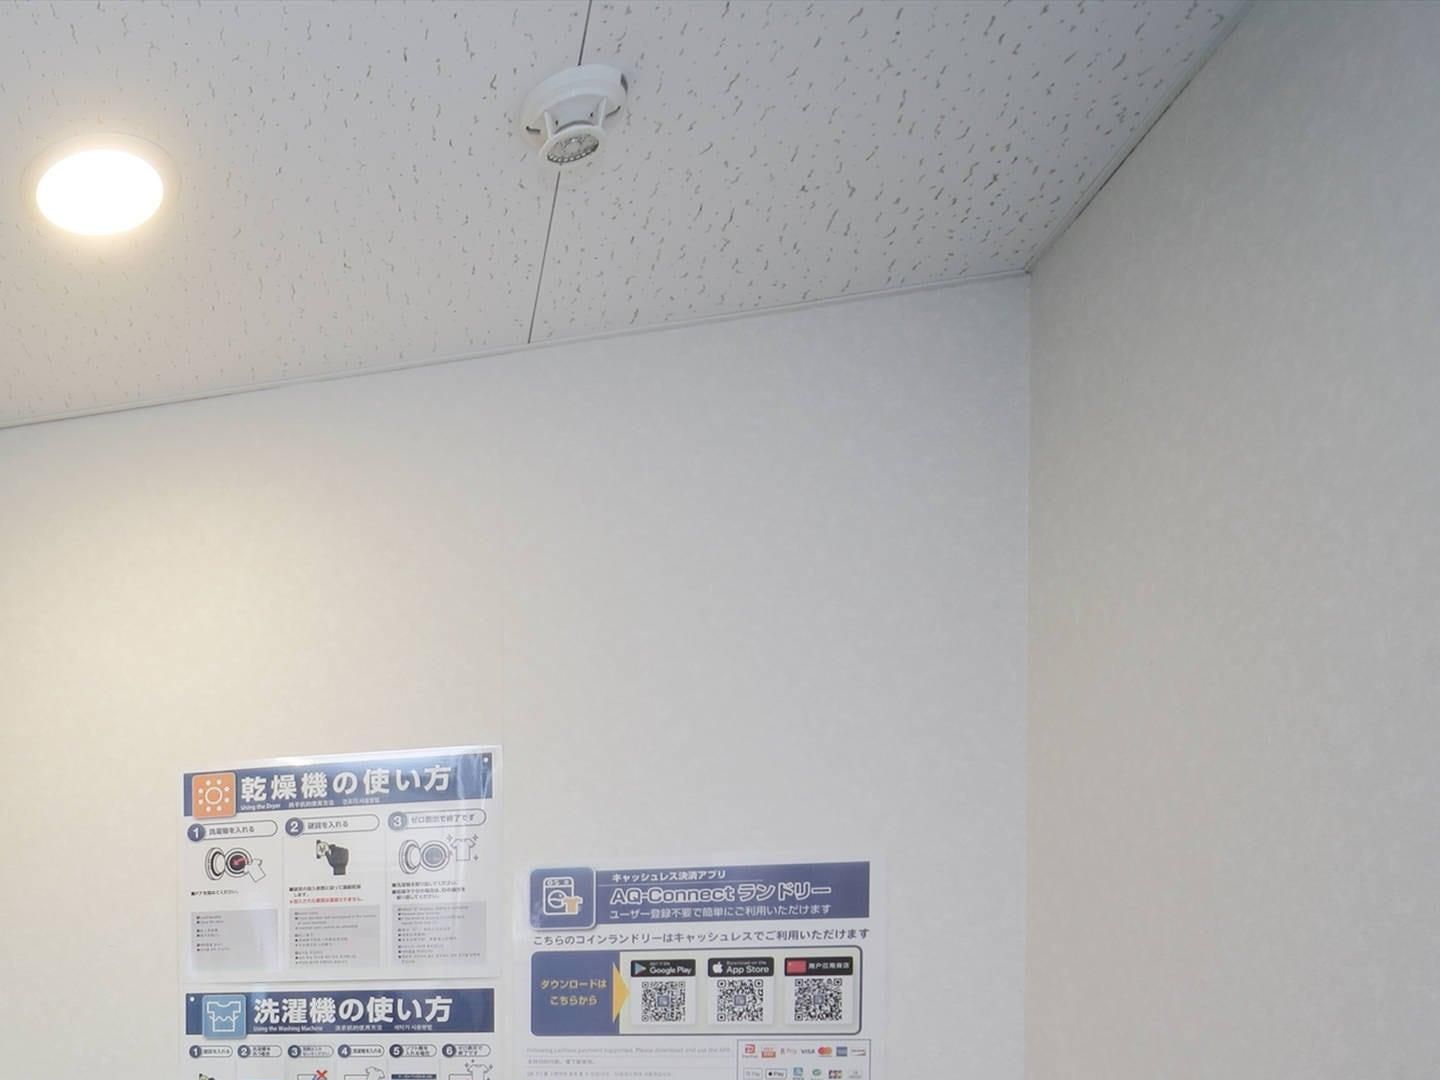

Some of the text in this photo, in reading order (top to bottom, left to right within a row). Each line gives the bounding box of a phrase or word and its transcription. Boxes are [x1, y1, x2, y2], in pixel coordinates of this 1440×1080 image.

[241, 766, 452, 802] 乾燥機の使い方
[208, 825, 255, 836] 洗濯物を入れる
[307, 820, 349, 830] 硬貨を入れる
[612, 870, 726, 883] キャッシュレス決済アプリ
[611, 882, 832, 905] AQ-Connect ランドリー
[610, 904, 831, 920] ユーザー登録不要で簡単にご利用いただけます
[533, 928, 870, 946] こちらのコインランドリーはキャッシュレスでご利用いただけます
[649, 966, 692, 976] Google Play
[726, 965, 769, 976] App Store
[541, 979, 607, 990] ダウンロードは
[550, 996, 597, 1007] こちらから
[253, 996, 453, 1025] 洗濯機の使い方
